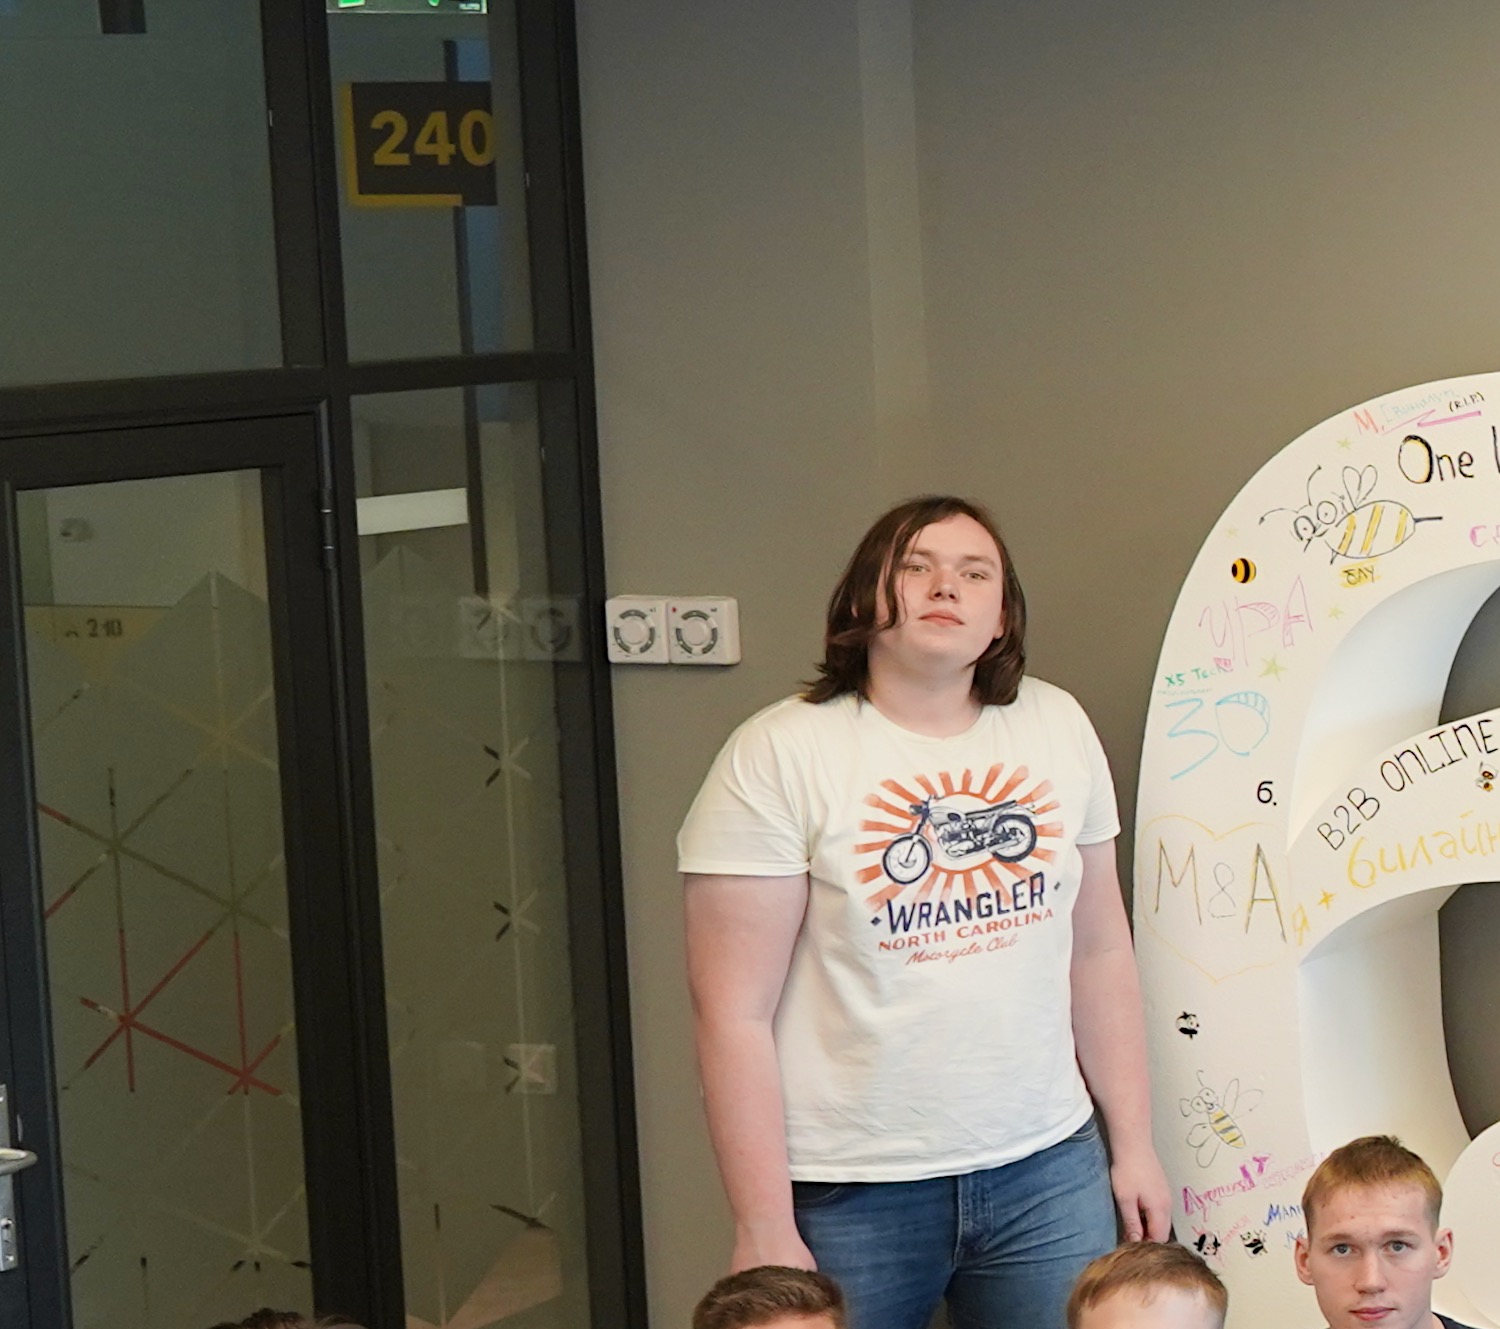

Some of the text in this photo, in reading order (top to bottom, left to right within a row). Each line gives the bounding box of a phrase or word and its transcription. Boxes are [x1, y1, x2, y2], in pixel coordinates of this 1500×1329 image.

[370, 109, 498, 168] 240
[1398, 434, 1475, 484] One
[1316, 786, 1381, 852] B2B
[886, 870, 1046, 935] WRANGLER
[878, 908, 1055, 952] NORTH CAROLINA
[905, 933, 1020, 966] Motorcycle Club
